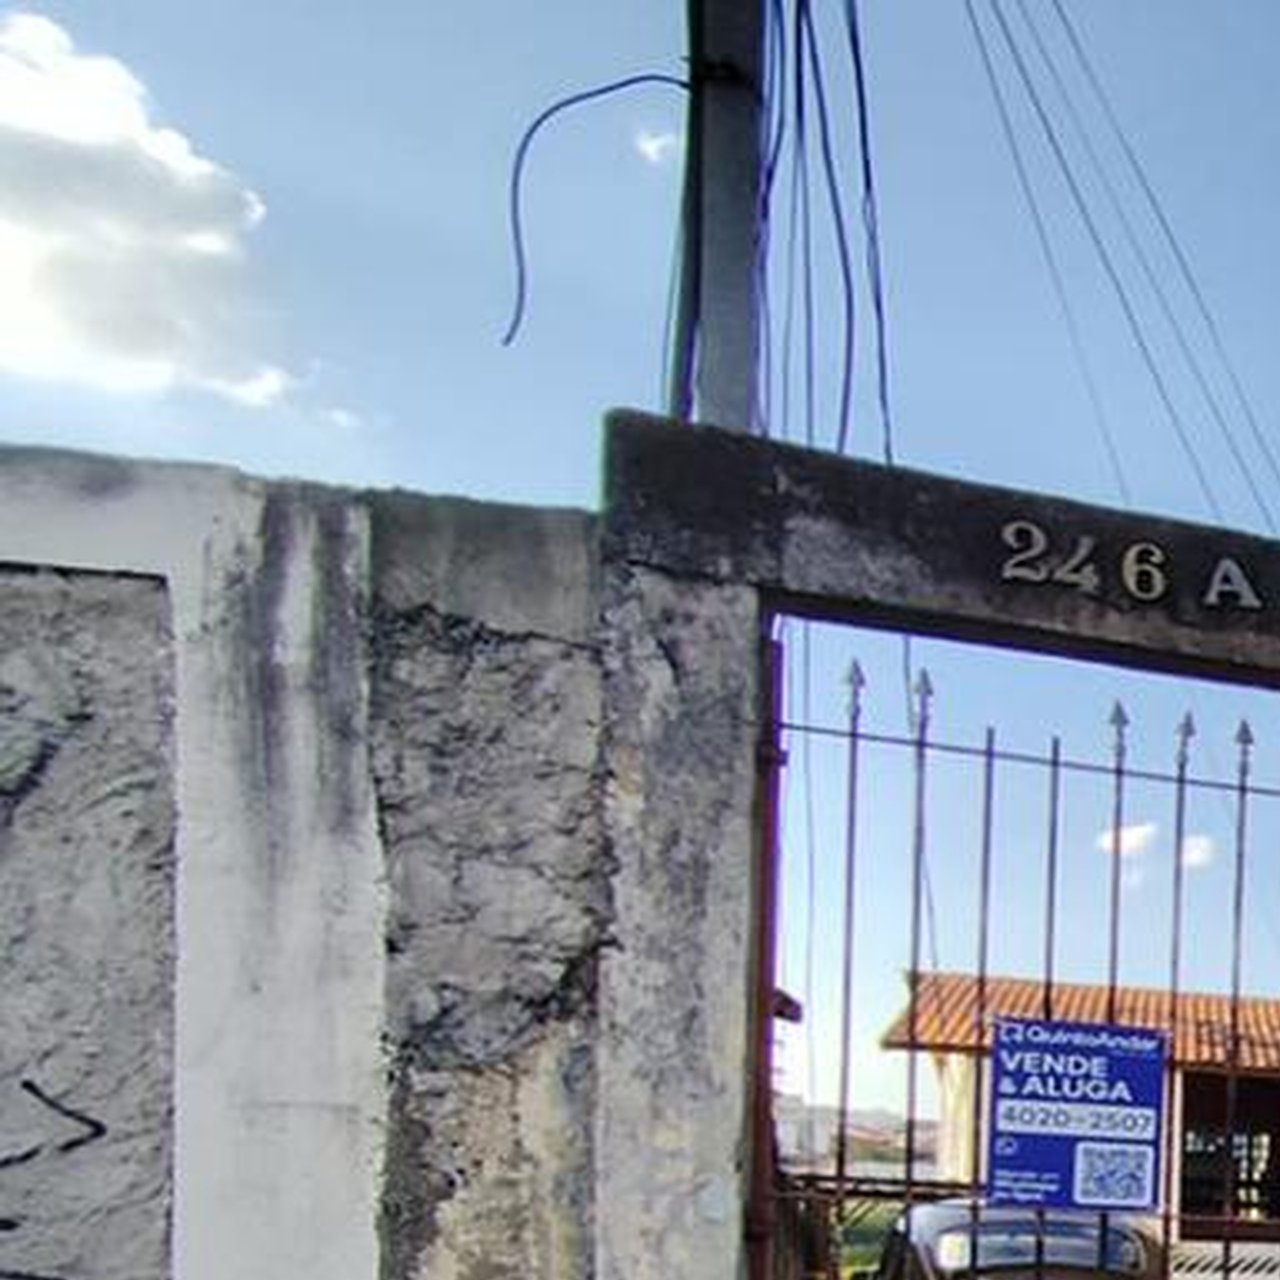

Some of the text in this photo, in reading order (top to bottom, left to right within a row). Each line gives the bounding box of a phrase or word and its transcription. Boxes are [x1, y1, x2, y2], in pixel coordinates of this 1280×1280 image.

[1002, 520, 1262, 609] 246 A
[1001, 1050, 1109, 1077] VENDE
[1022, 1076, 1133, 1102] ALUGA
